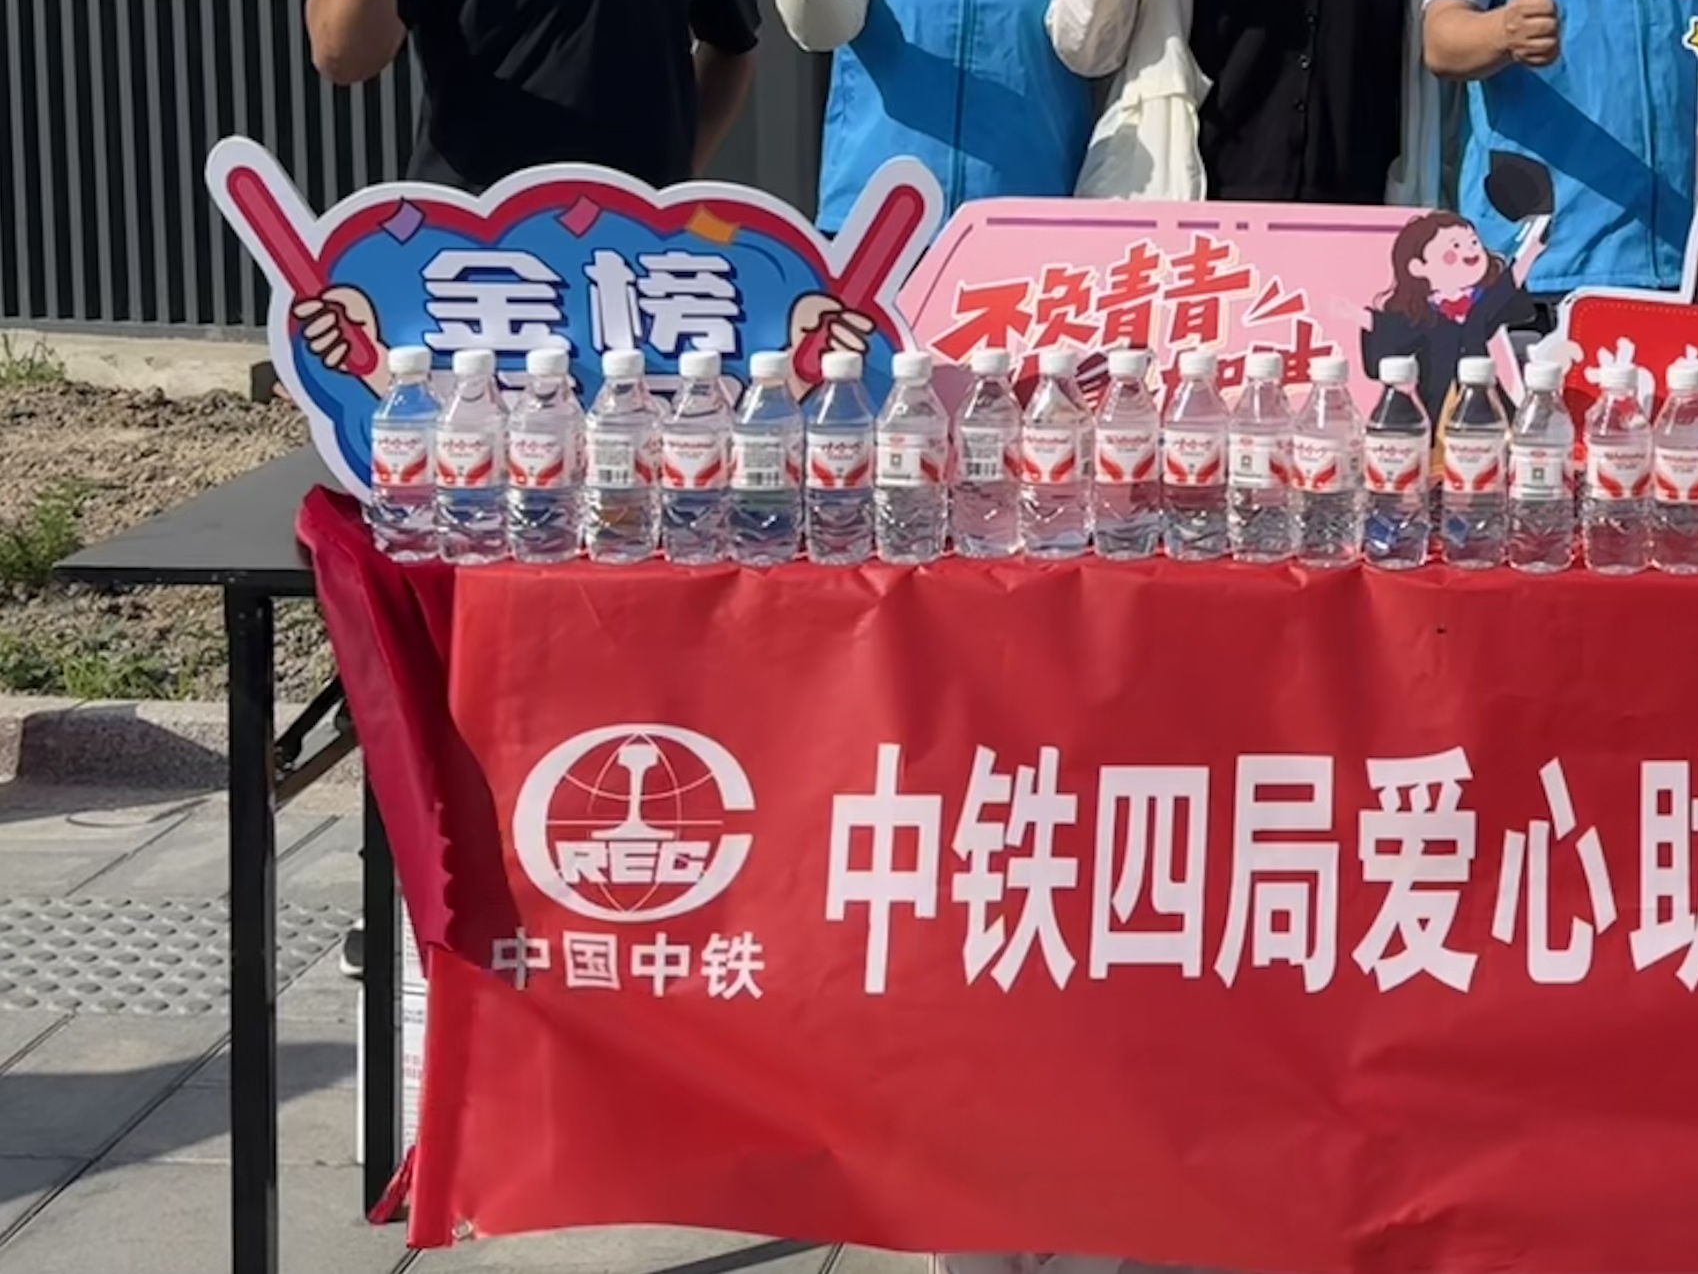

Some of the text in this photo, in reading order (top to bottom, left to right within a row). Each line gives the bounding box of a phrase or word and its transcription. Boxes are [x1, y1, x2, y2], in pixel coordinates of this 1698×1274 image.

[421, 249, 740, 356] 金榜
[492, 927, 766, 1000] 中国中铁
